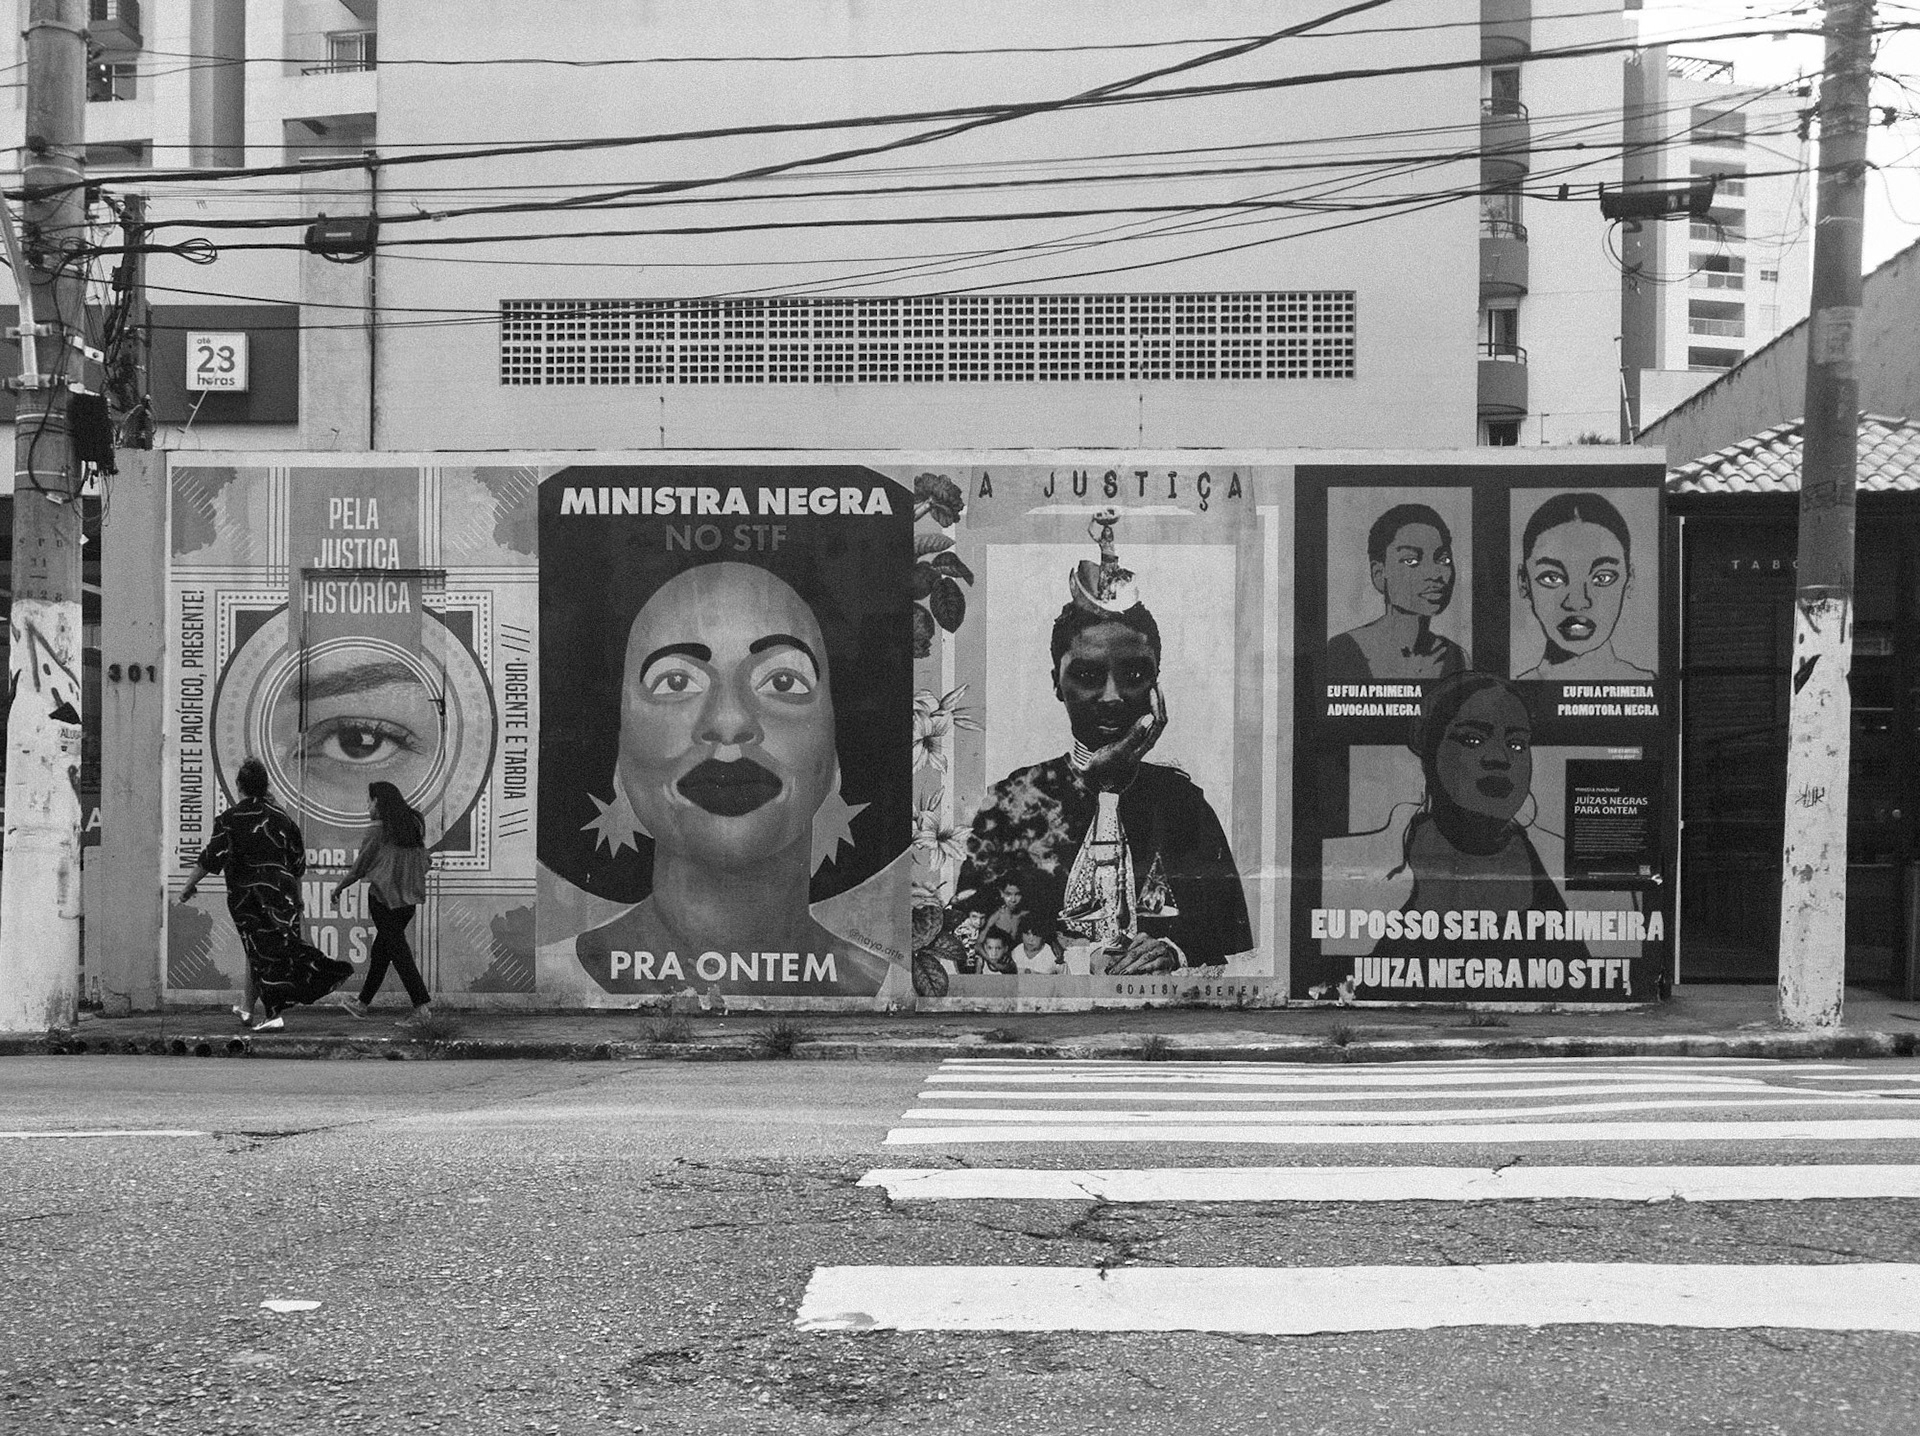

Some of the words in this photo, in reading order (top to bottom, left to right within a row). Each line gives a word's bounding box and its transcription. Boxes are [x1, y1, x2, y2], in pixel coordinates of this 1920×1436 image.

[197, 345, 236, 373] 23
[197, 373, 236, 386] horas
[560, 486, 750, 515] MINISTRA
[758, 486, 893, 516] NEGRA
[978, 470, 994, 499] A
[1043, 469, 1243, 512] JUSTIÇA
[329, 497, 379, 530] PELA
[665, 524, 723, 551] NO
[732, 524, 787, 552] STF
[181, 590, 205, 668] PRESENTE!
[108, 663, 156, 684] 301
[505, 663, 528, 728] URGENTE
[1327, 685, 1341, 698] EU
[1342, 685, 1360, 698] FUI
[1360, 685, 1368, 698] A
[1369, 685, 1423, 698] PRIMEIRA
[1563, 686, 1577, 698] EU
[1577, 686, 1594, 698] FUI
[1594, 686, 1602, 698] A
[1603, 686, 1654, 698] PRIMEIRA
[175, 674, 208, 743] PACÍFICO,
[1386, 704, 1422, 717] NEGRA
[1558, 704, 1622, 716] PROMOTORA
[1624, 704, 1660, 716] NEGRA
[504, 748, 527, 800] TARDIA
[179, 748, 204, 832] BERNADETE
[1575, 795, 1607, 805] JUÍZAS
[1610, 797, 1648, 806] NEGRAS
[1574, 806, 1600, 814] PARA
[1602, 806, 1638, 815] ONTEM
[174, 837, 203, 869] MÃE
[1310, 909, 1346, 940] EU
[1349, 909, 1440, 940] POSSO
[1443, 910, 1499, 941] SER
[1502, 910, 1524, 941] A
[1526, 910, 1665, 941] PRIMEIRA
[610, 951, 686, 981] PRA
[696, 951, 839, 983] ONTEM
[1353, 957, 1426, 988] JUIZA
[1428, 958, 1525, 989] NEGRA
[1527, 958, 1565, 989] NO
[1567, 958, 1632, 993] STF!
